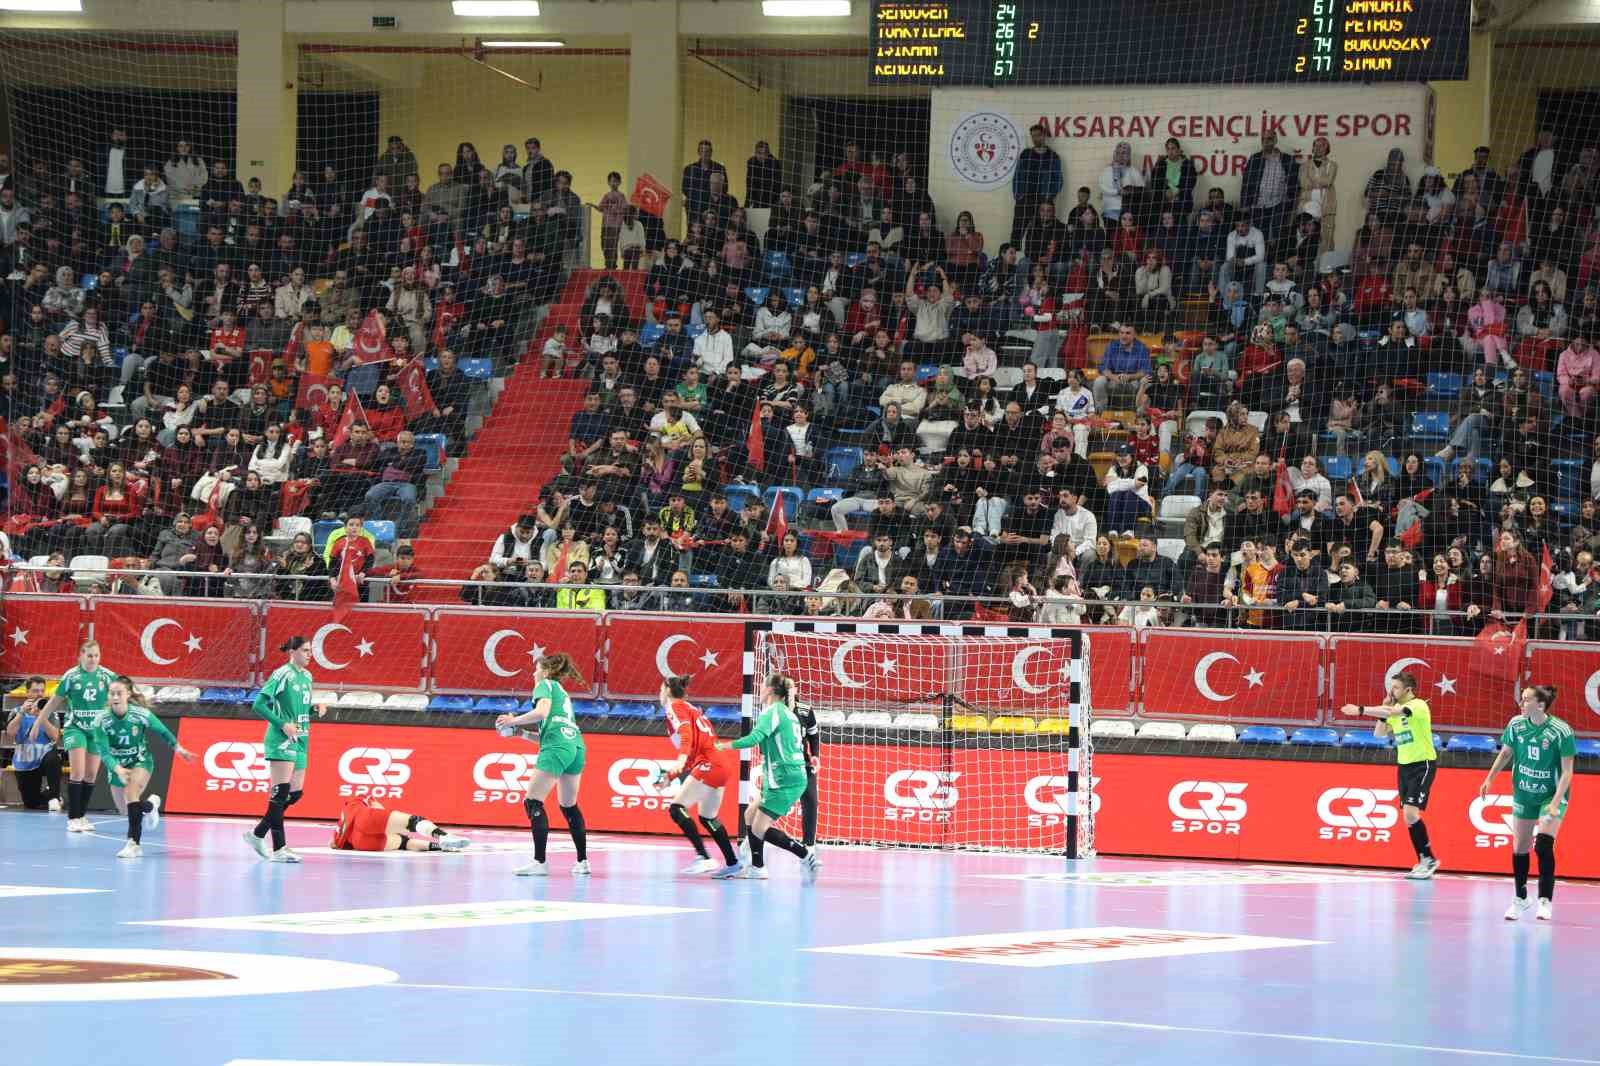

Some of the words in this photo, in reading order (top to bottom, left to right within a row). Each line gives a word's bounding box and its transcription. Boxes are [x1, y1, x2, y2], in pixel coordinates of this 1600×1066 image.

[996, 4, 1016, 20] 24
[995, 22, 1015, 39] 26
[1028, 22, 1039, 39] 2
[1296, 18, 1308, 35] 2
[1314, 18, 1333, 33] 71
[995, 41, 1014, 57] 47
[1313, 37, 1332, 52] 74
[994, 60, 1013, 76] 67
[1295, 56, 1306, 73] 2
[1312, 55, 1331, 71] 77
[1038, 115, 1160, 138] AKSARAY
[1293, 114, 1329, 137] VE
[1335, 113, 1412, 137] SPOR
[82, 688, 97, 701] 42
[1527, 745, 1540, 761] 19
[338, 746, 415, 785] CRS
[205, 779, 270, 793] SPOR
[339, 785, 404, 799] SPOR
[473, 790, 522, 804] SPO
[1168, 780, 1249, 821] CRS
[885, 808, 951, 823] SPOR
[1316, 787, 1400, 829] CRS
[1171, 820, 1241, 835] SPOR
[1319, 827, 1391, 842] SPOR
